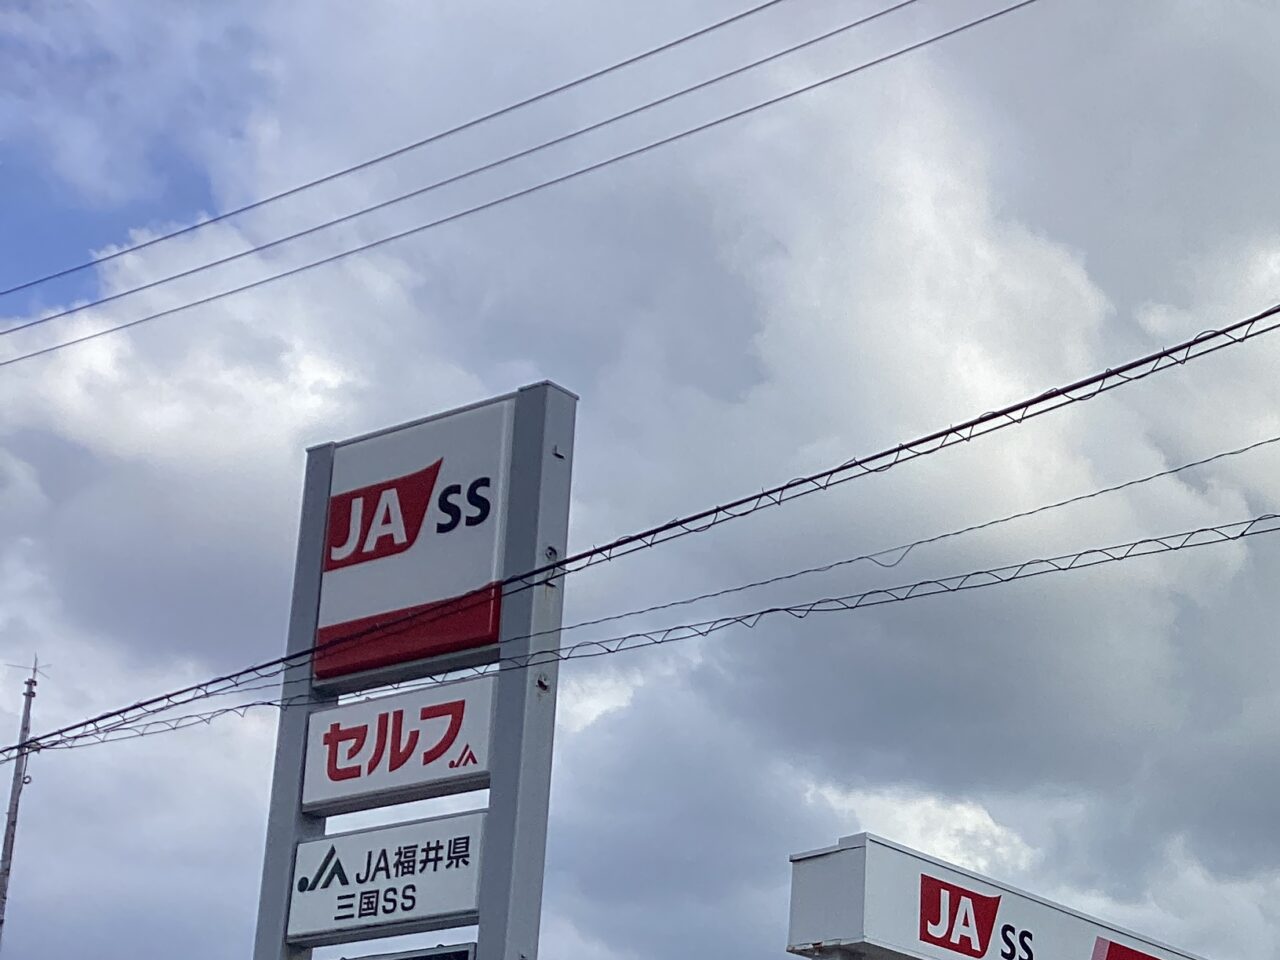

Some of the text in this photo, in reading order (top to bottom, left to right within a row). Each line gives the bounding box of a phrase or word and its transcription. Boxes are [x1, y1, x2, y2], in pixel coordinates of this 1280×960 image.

[331, 477, 491, 561] JA SS
[323, 699, 466, 781] セルフ
[356, 836, 471, 884] JA福井県
[334, 884, 416, 921] 三国SS
[928, 889, 981, 951] JA
